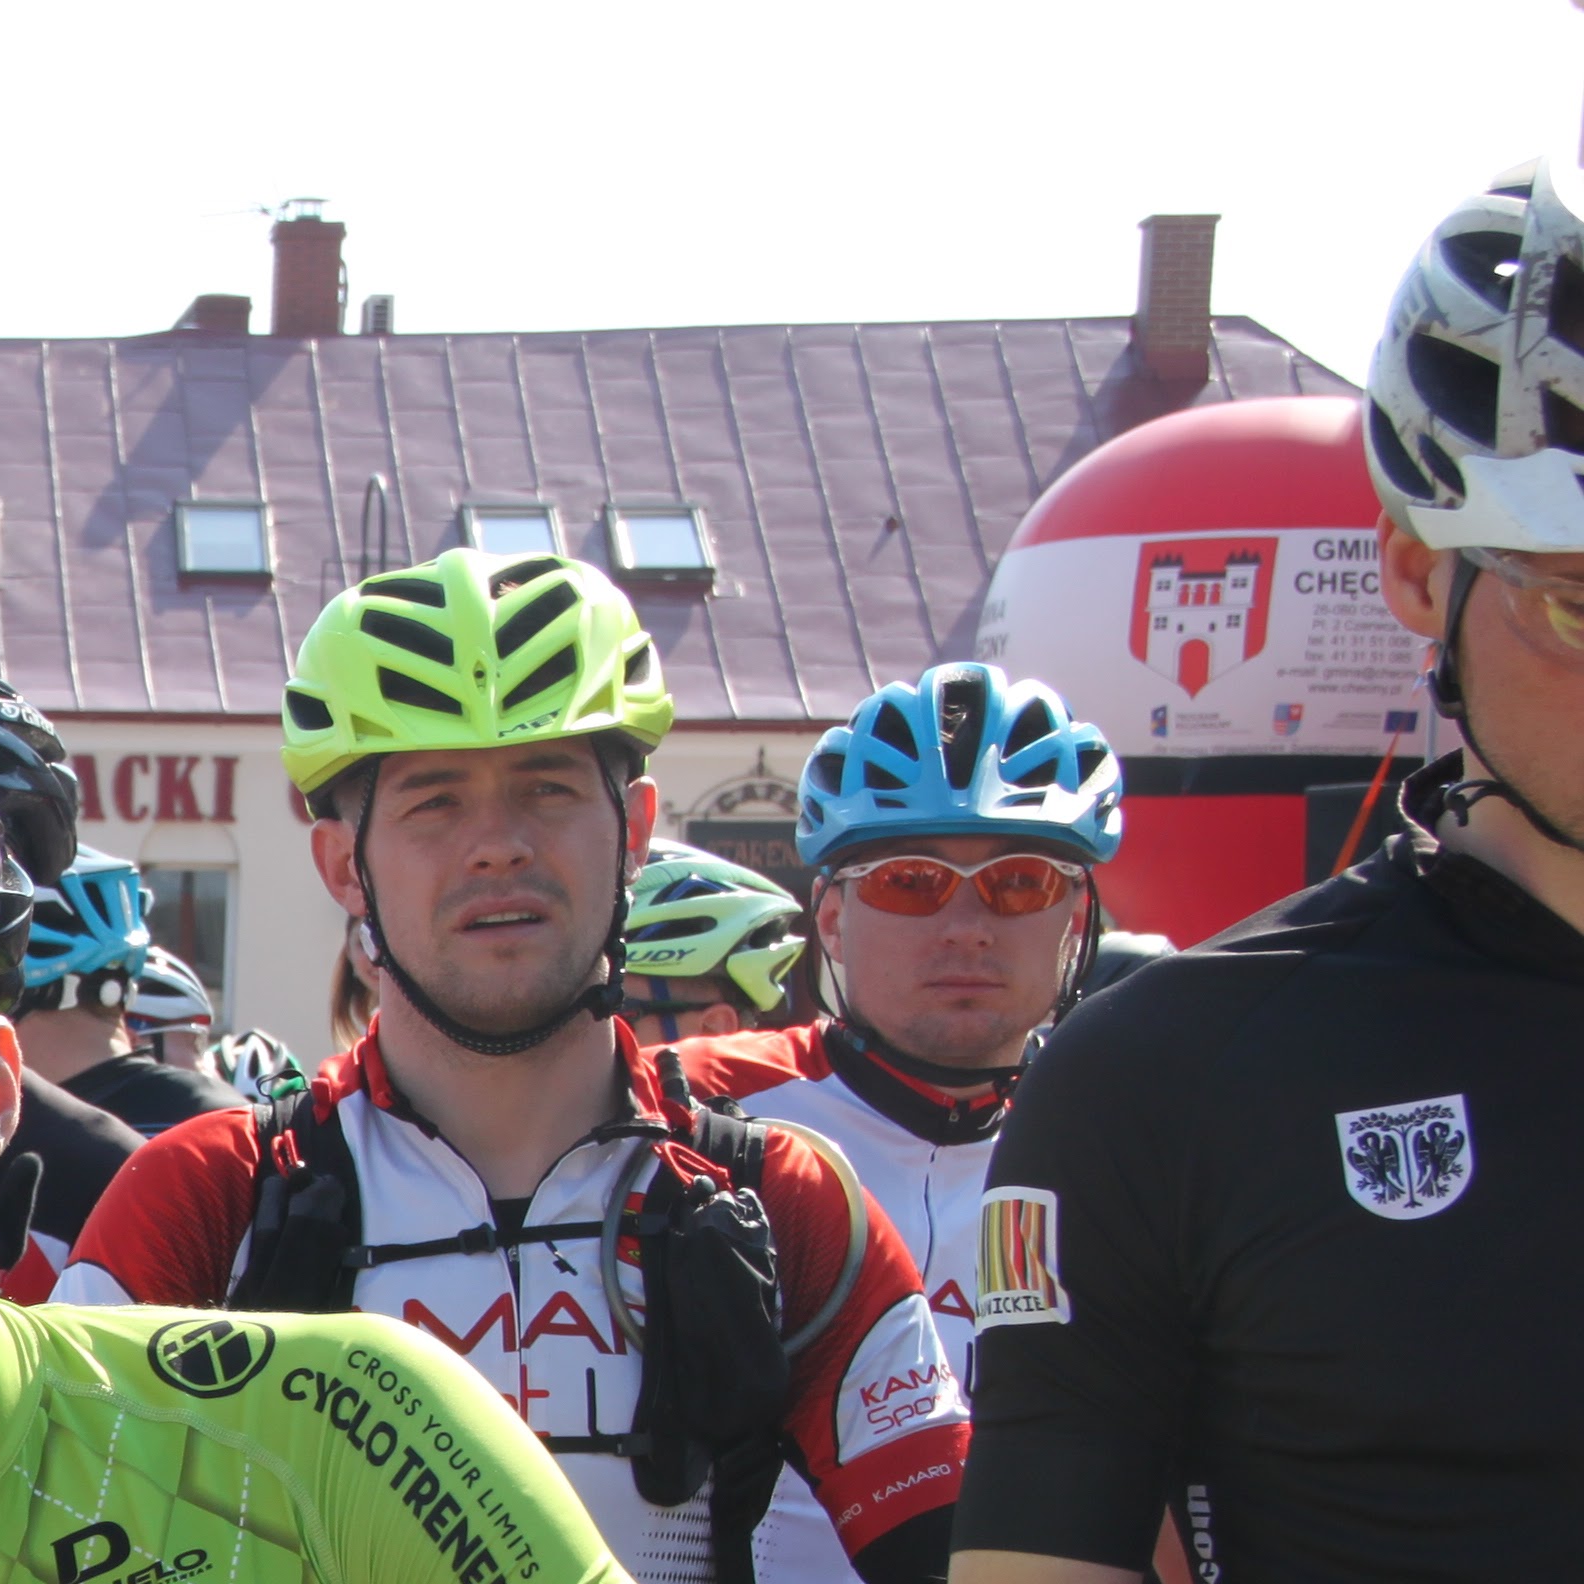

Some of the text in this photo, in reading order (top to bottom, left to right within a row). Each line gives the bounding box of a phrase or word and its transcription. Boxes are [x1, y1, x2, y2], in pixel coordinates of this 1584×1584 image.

[625, 947, 697, 962] UDY
[347, 1348, 540, 1581] CROSS YOUR LIMITS
[872, 1462, 952, 1502] KAMARO
